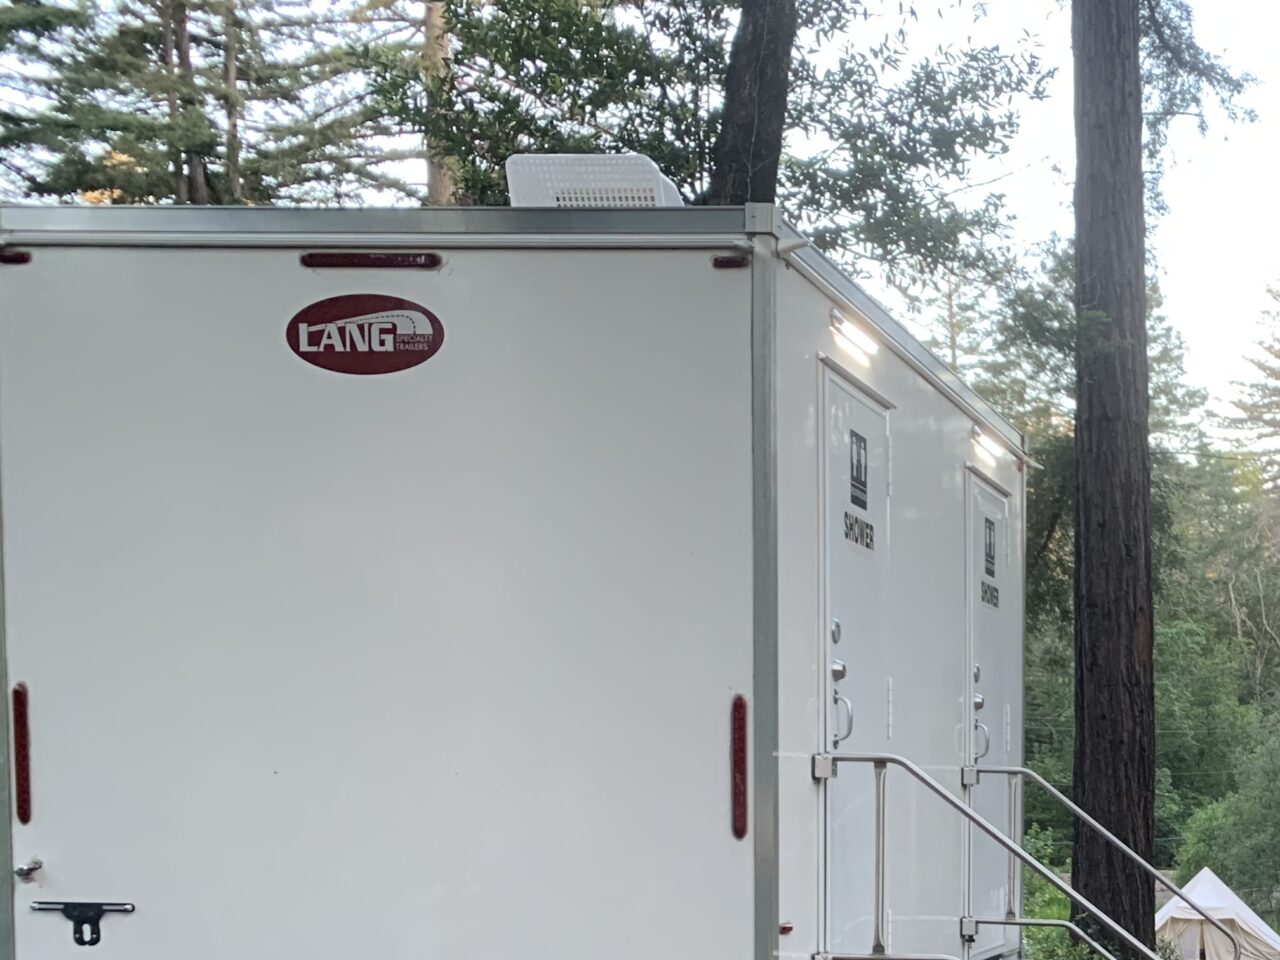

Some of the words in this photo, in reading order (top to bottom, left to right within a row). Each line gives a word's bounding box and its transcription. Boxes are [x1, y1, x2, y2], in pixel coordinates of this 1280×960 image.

[298, 322, 395, 352] LANG
[395, 334, 434, 342] SPECIALTY
[396, 342, 429, 351] TRAILERS
[844, 511, 875, 551] SHOWER
[981, 580, 1000, 608] SHOWER
